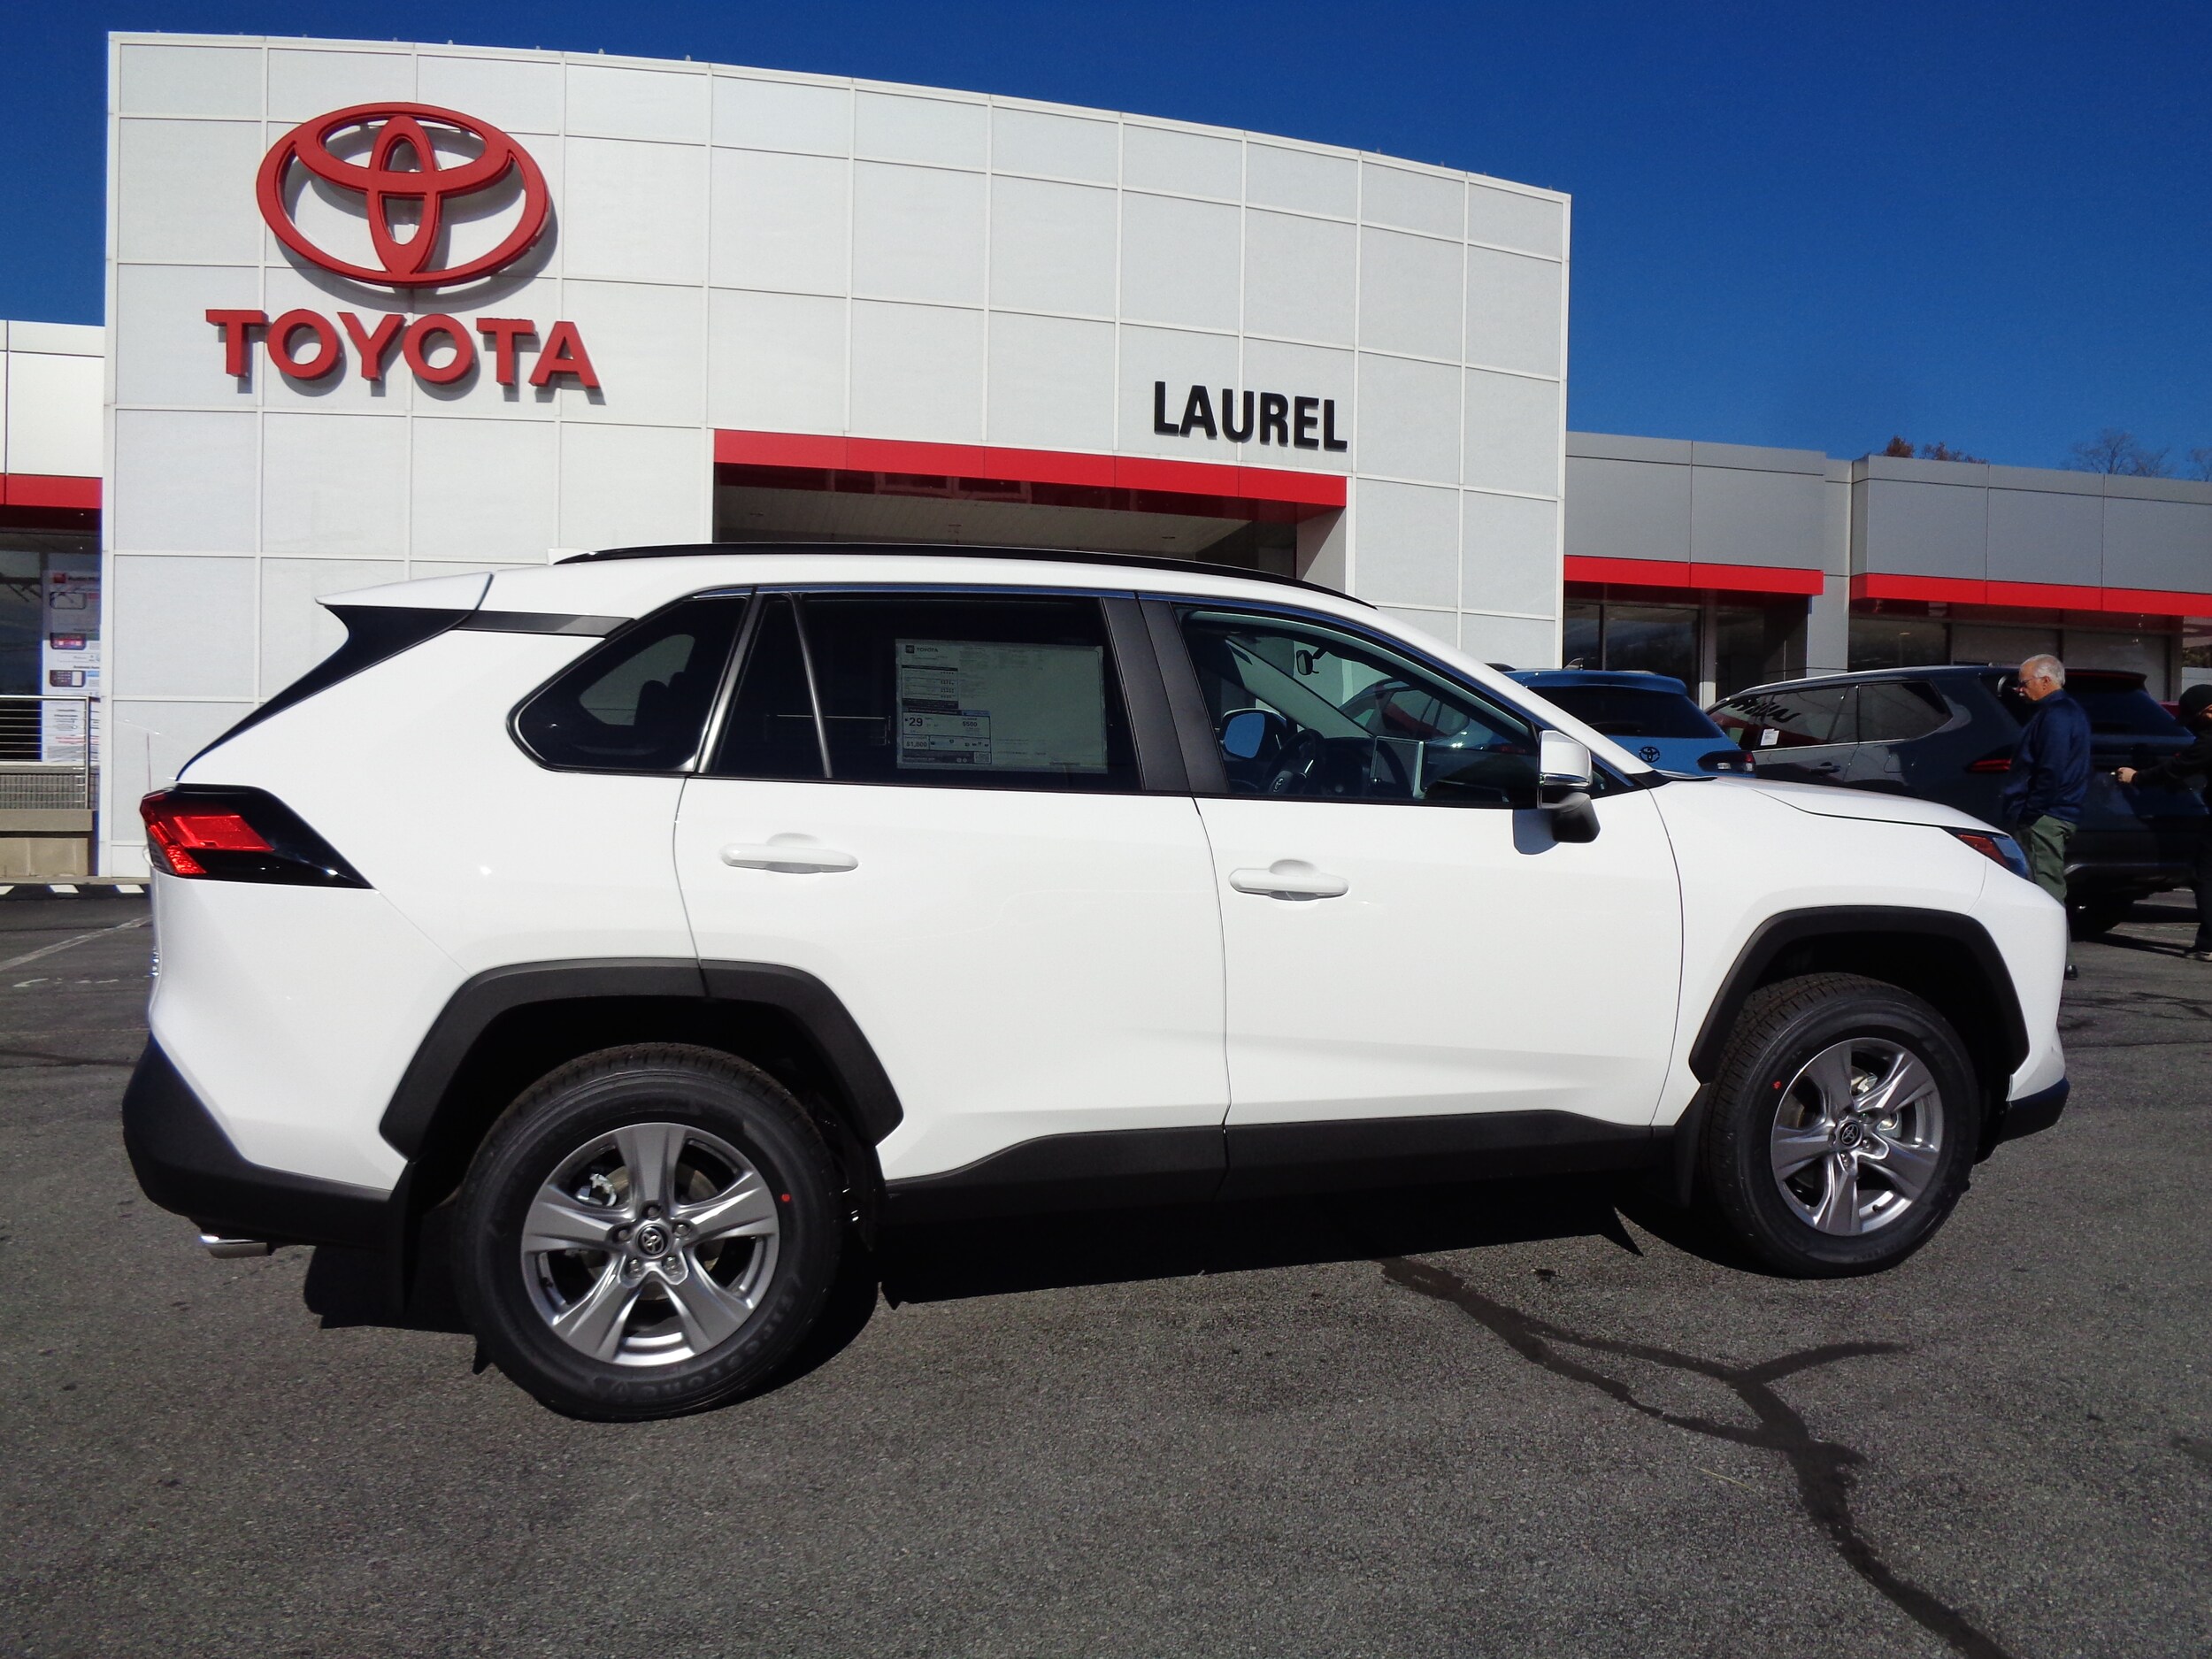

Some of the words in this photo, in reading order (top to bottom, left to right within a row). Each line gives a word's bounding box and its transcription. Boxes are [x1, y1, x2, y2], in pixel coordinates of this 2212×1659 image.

[205, 308, 601, 388] TOYOTA
[1154, 380, 1348, 450] LAUREL
[909, 717, 924, 727] 29
